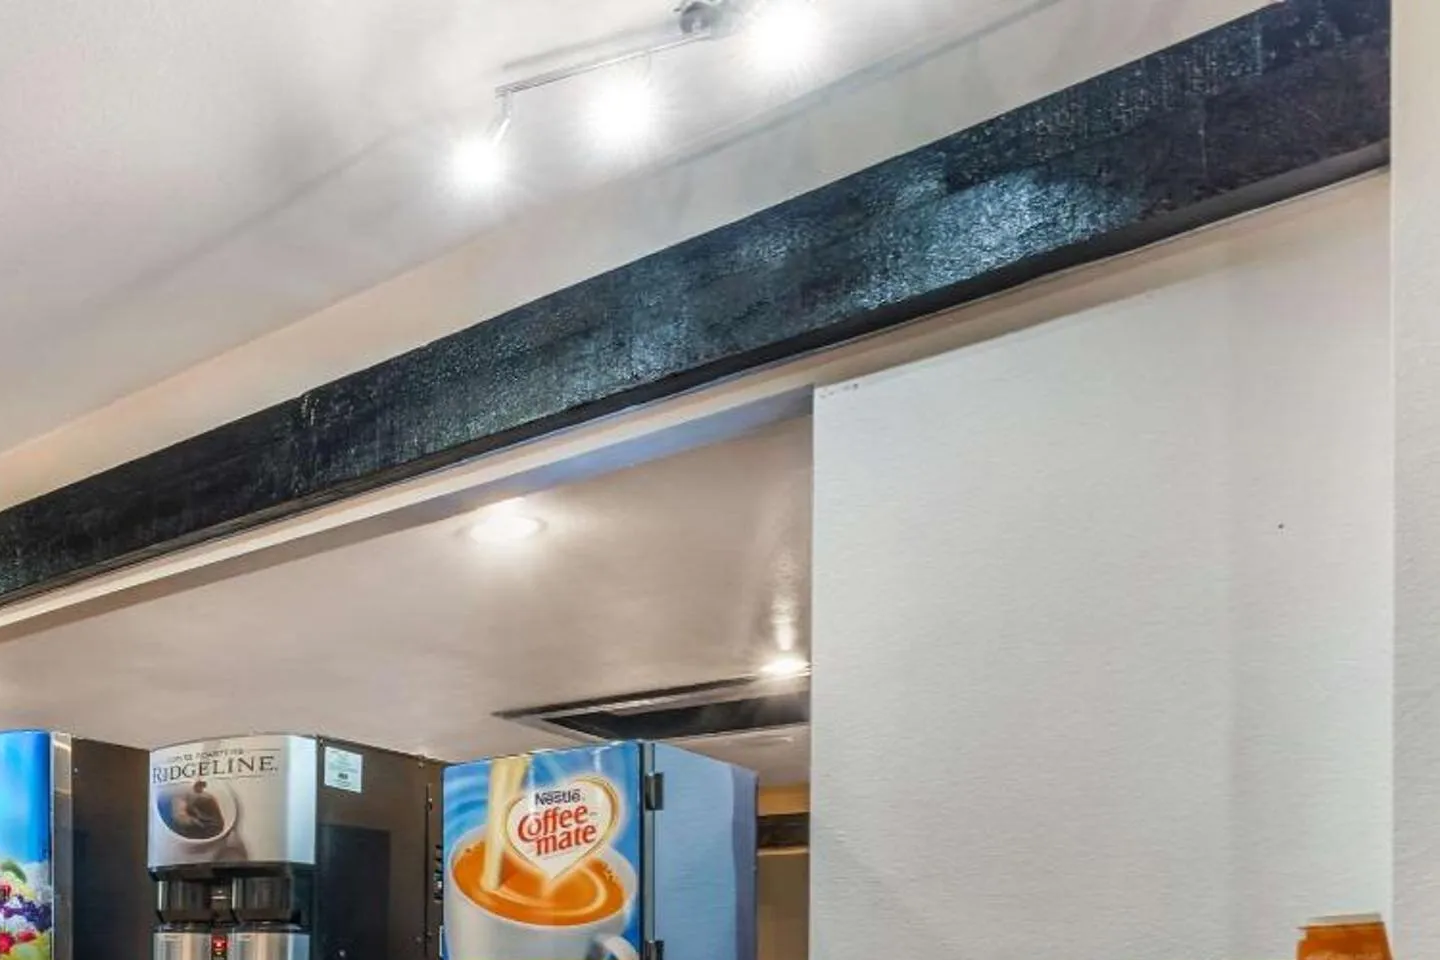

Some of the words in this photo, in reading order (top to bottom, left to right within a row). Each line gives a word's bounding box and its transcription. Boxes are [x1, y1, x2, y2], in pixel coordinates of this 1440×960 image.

[152, 755, 275, 784] RIDGELINE
[534, 788, 582, 806] Nestlé
[518, 805, 589, 843] Coffee
[536, 824, 597, 856] mate
